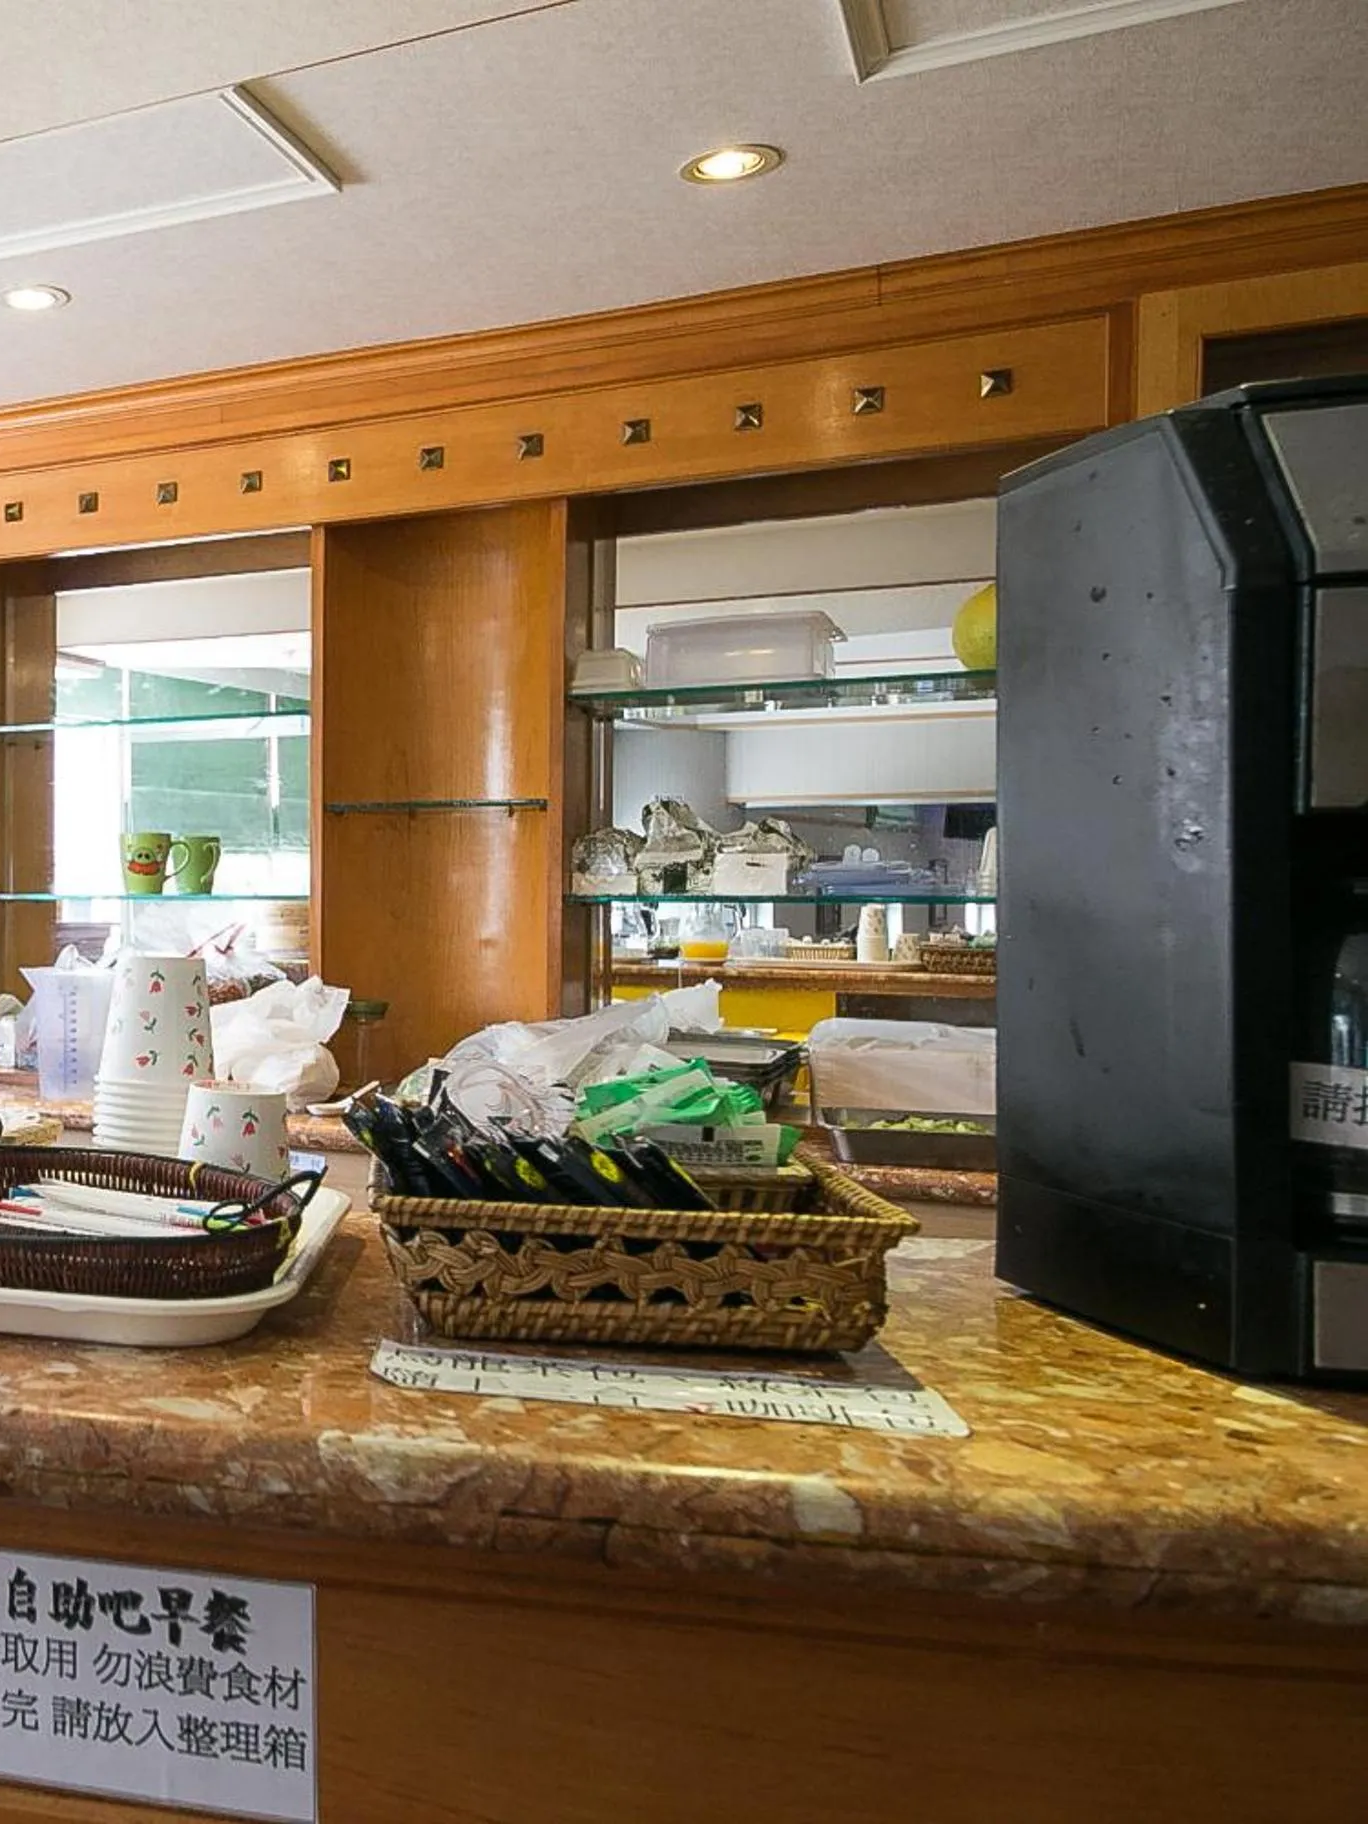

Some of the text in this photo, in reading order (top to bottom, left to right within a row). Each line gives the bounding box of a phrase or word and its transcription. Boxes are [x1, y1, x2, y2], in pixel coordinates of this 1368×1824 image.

[93, 1643, 307, 1710] 勿浪費食材
[52, 1695, 307, 1771] 請放入整理箱
